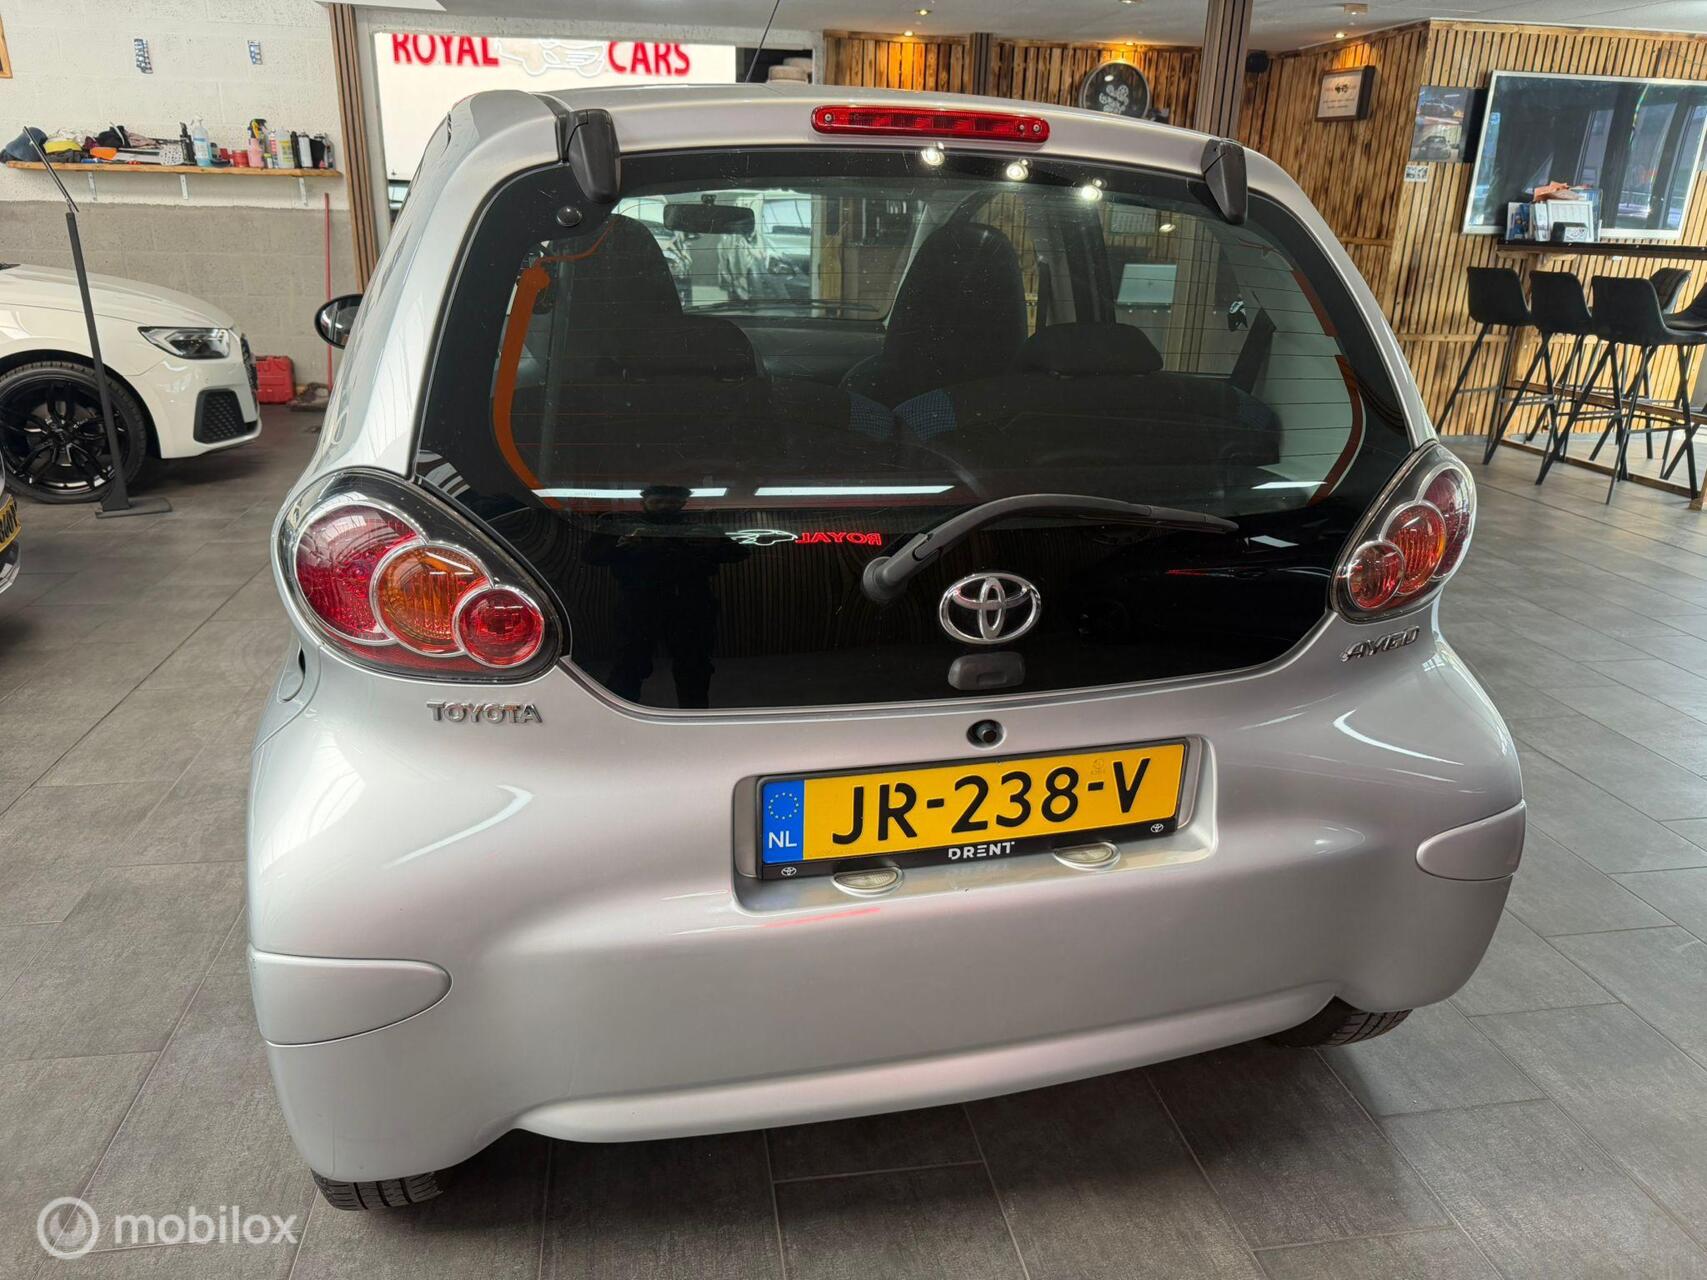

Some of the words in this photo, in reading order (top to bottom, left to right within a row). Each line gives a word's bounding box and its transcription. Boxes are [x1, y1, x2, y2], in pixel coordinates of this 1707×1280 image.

[391, 32, 499, 67] ROYAL
[607, 40, 691, 76] CARS
[1341, 625, 1420, 662] AYGO
[426, 701, 543, 724] TOYOTA
[832, 758, 1151, 845] JR-238-V
[768, 830, 798, 849] NL
[948, 841, 1016, 860] DRENT
